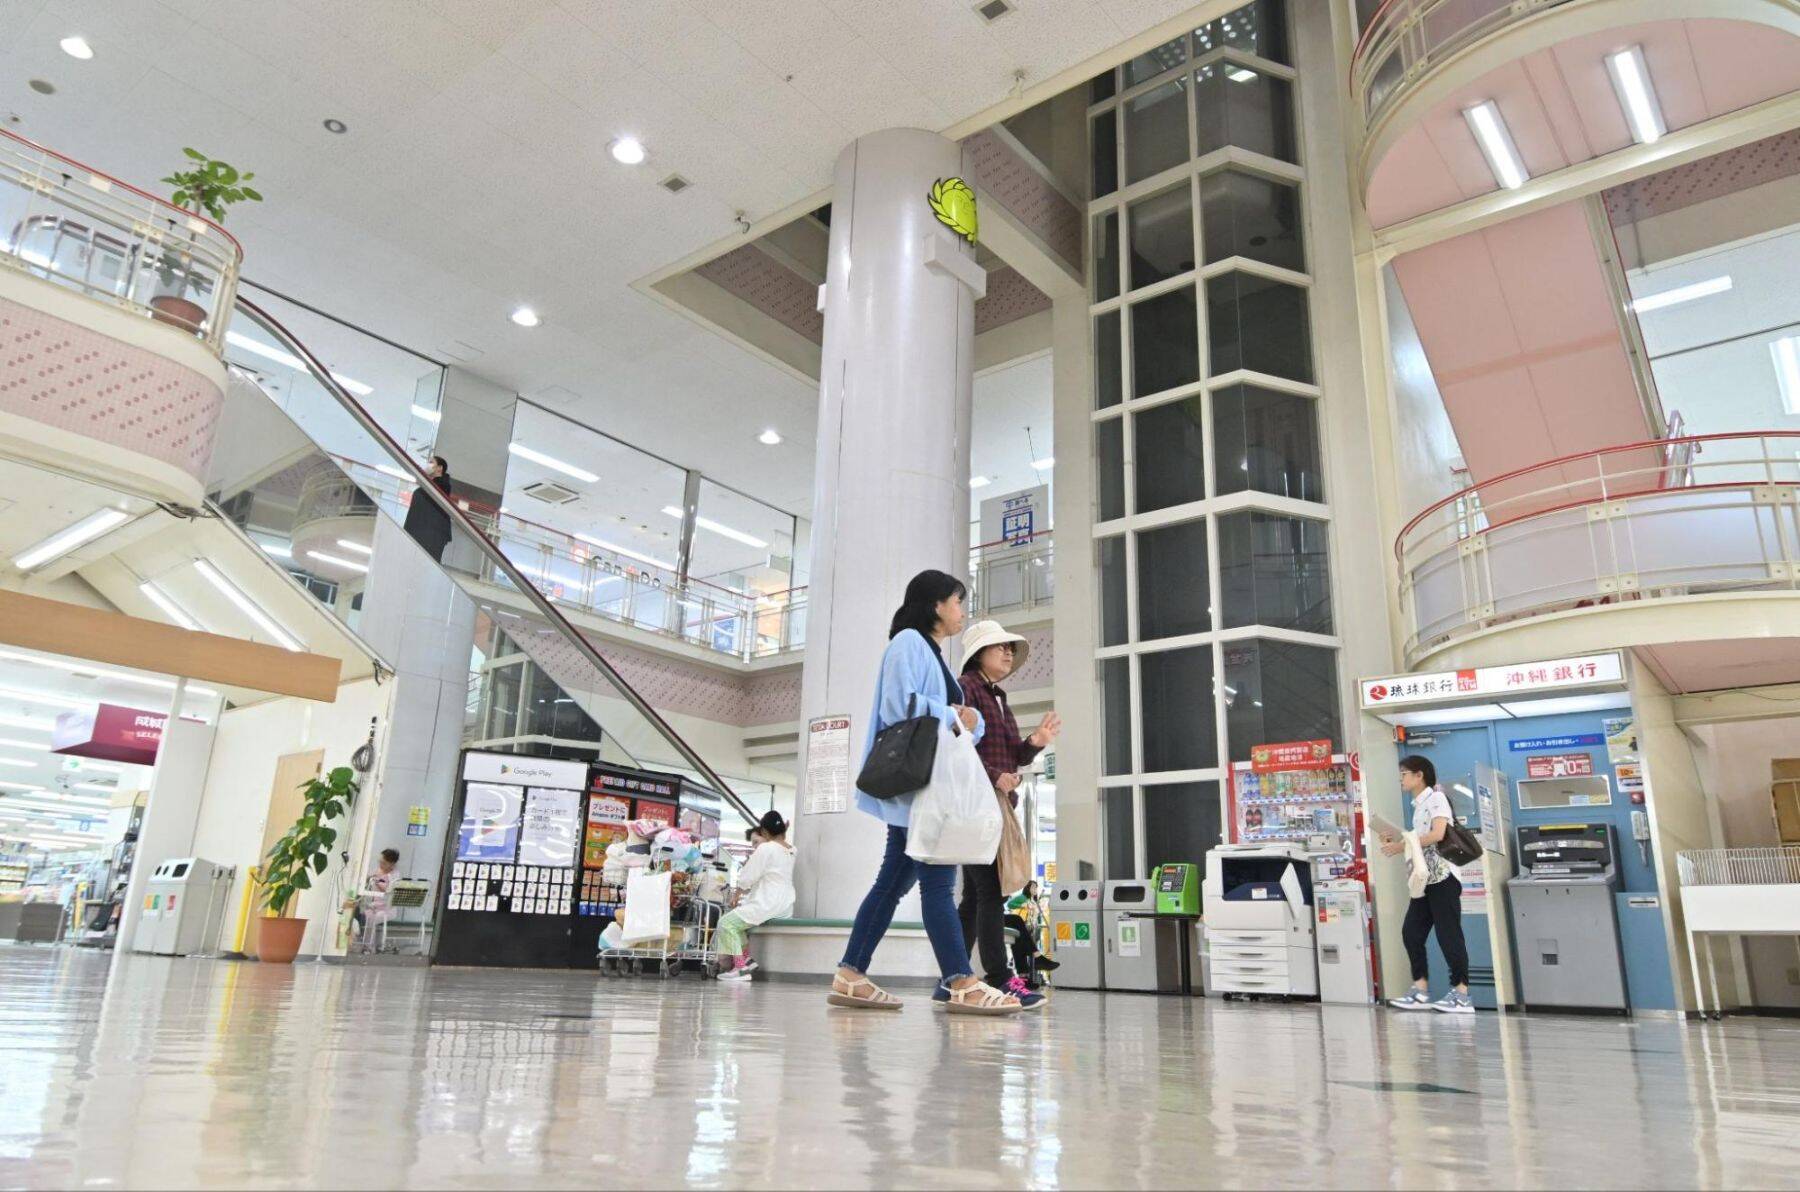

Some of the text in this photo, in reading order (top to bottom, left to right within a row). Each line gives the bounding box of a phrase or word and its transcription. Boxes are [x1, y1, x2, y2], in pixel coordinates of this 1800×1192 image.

[1506, 662, 1597, 686] 沖縄銀行
[1390, 679, 1453, 698] 琉球銀行
[513, 766, 552, 777] Google Play
[592, 803, 626, 814] プレゼントに
